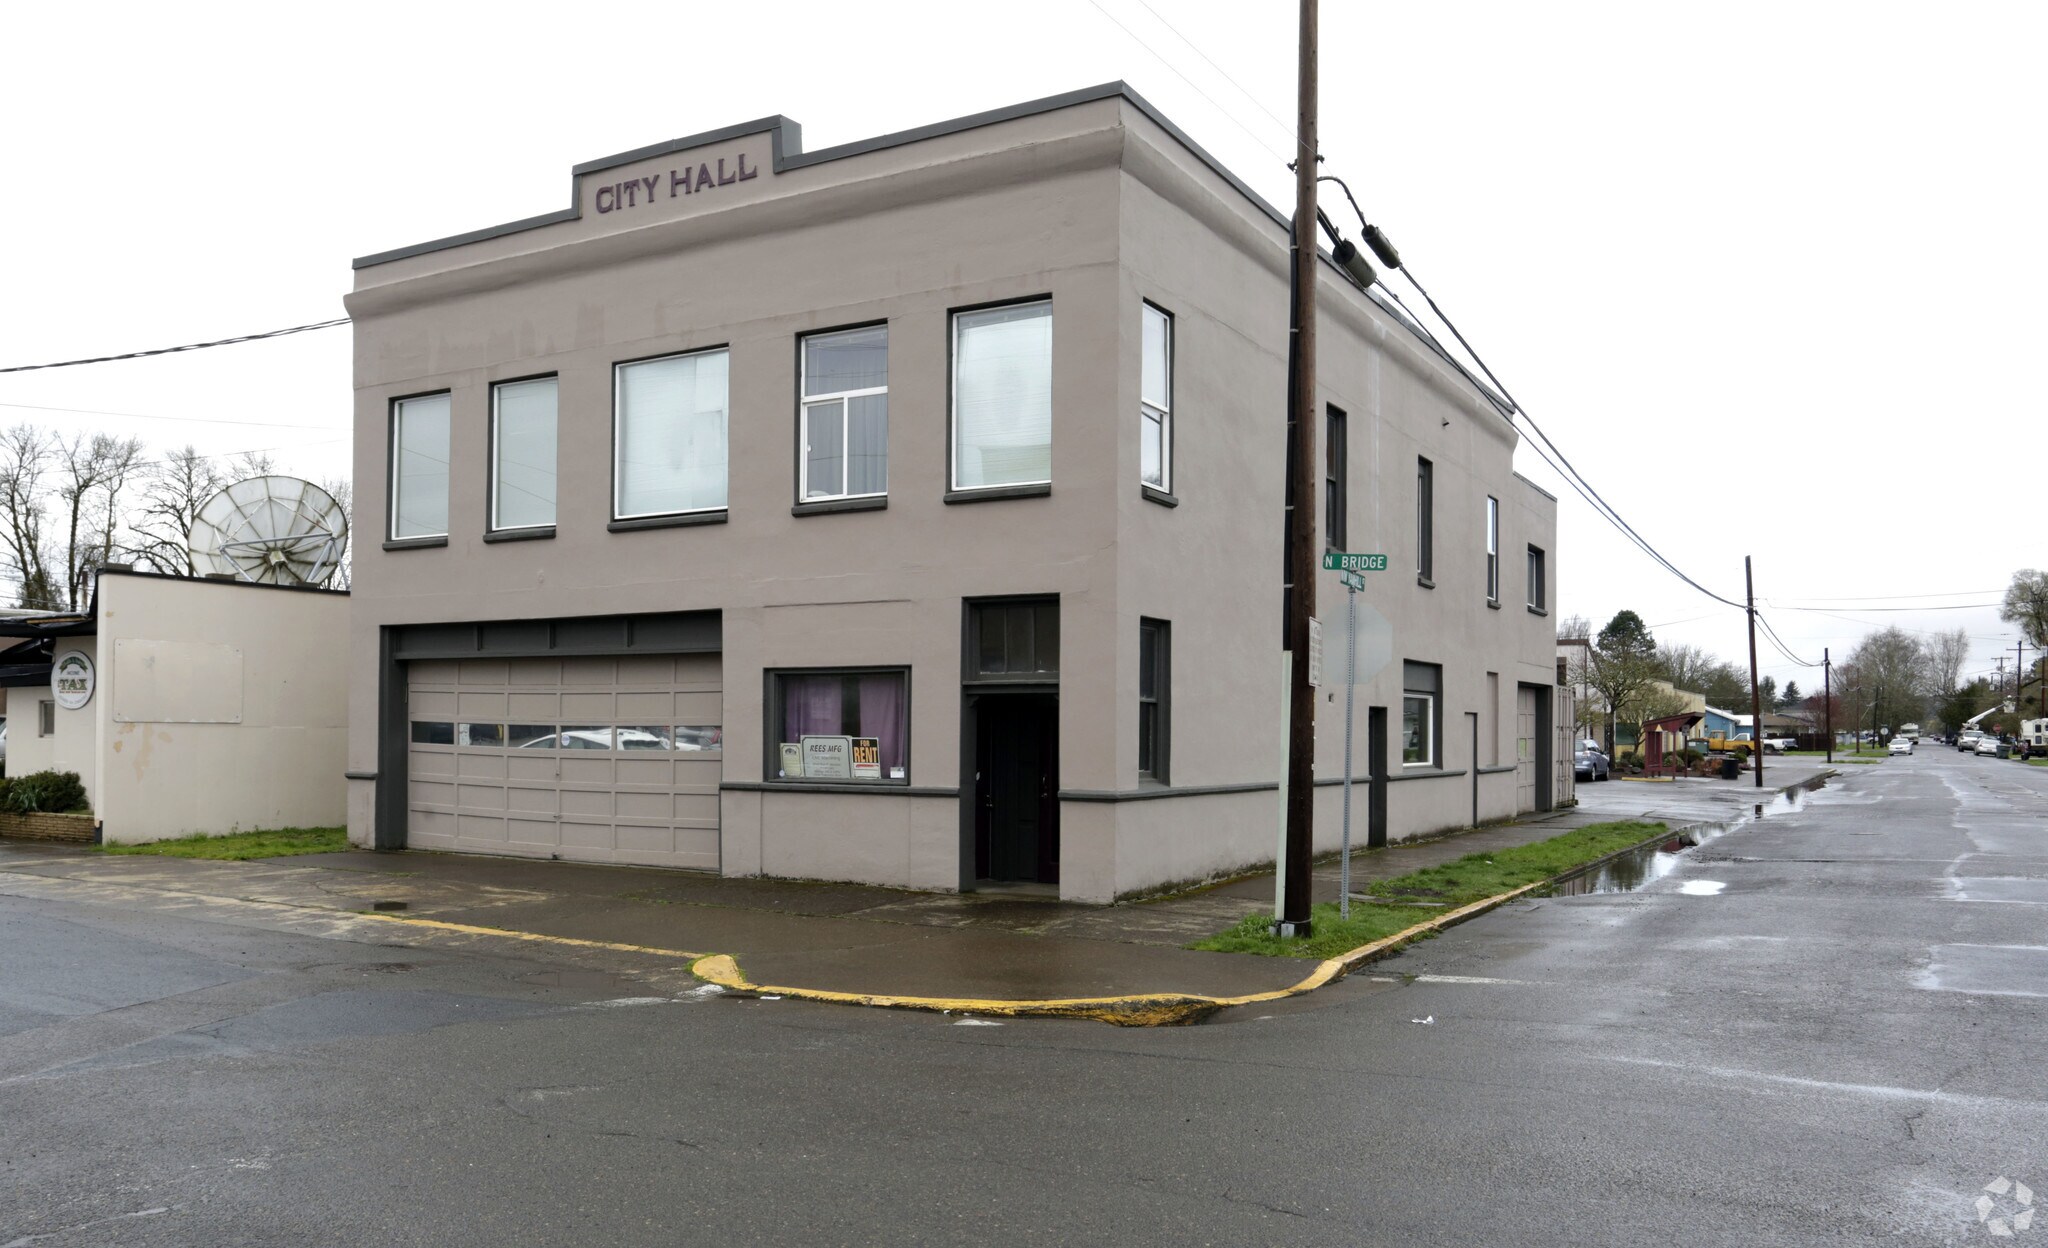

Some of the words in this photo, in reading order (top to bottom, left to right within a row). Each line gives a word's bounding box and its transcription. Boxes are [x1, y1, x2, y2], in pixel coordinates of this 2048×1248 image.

[595, 174, 660, 214] CITY
[670, 153, 758, 198] HALL
[1325, 555, 1333, 568] N
[1341, 556, 1385, 569] BRIDGE
[58, 679, 87, 690] TAX
[810, 744, 826, 752] REES
[827, 745, 842, 753] MFG
[860, 739, 870, 747] FOR
[854, 746, 878, 763] RENT
